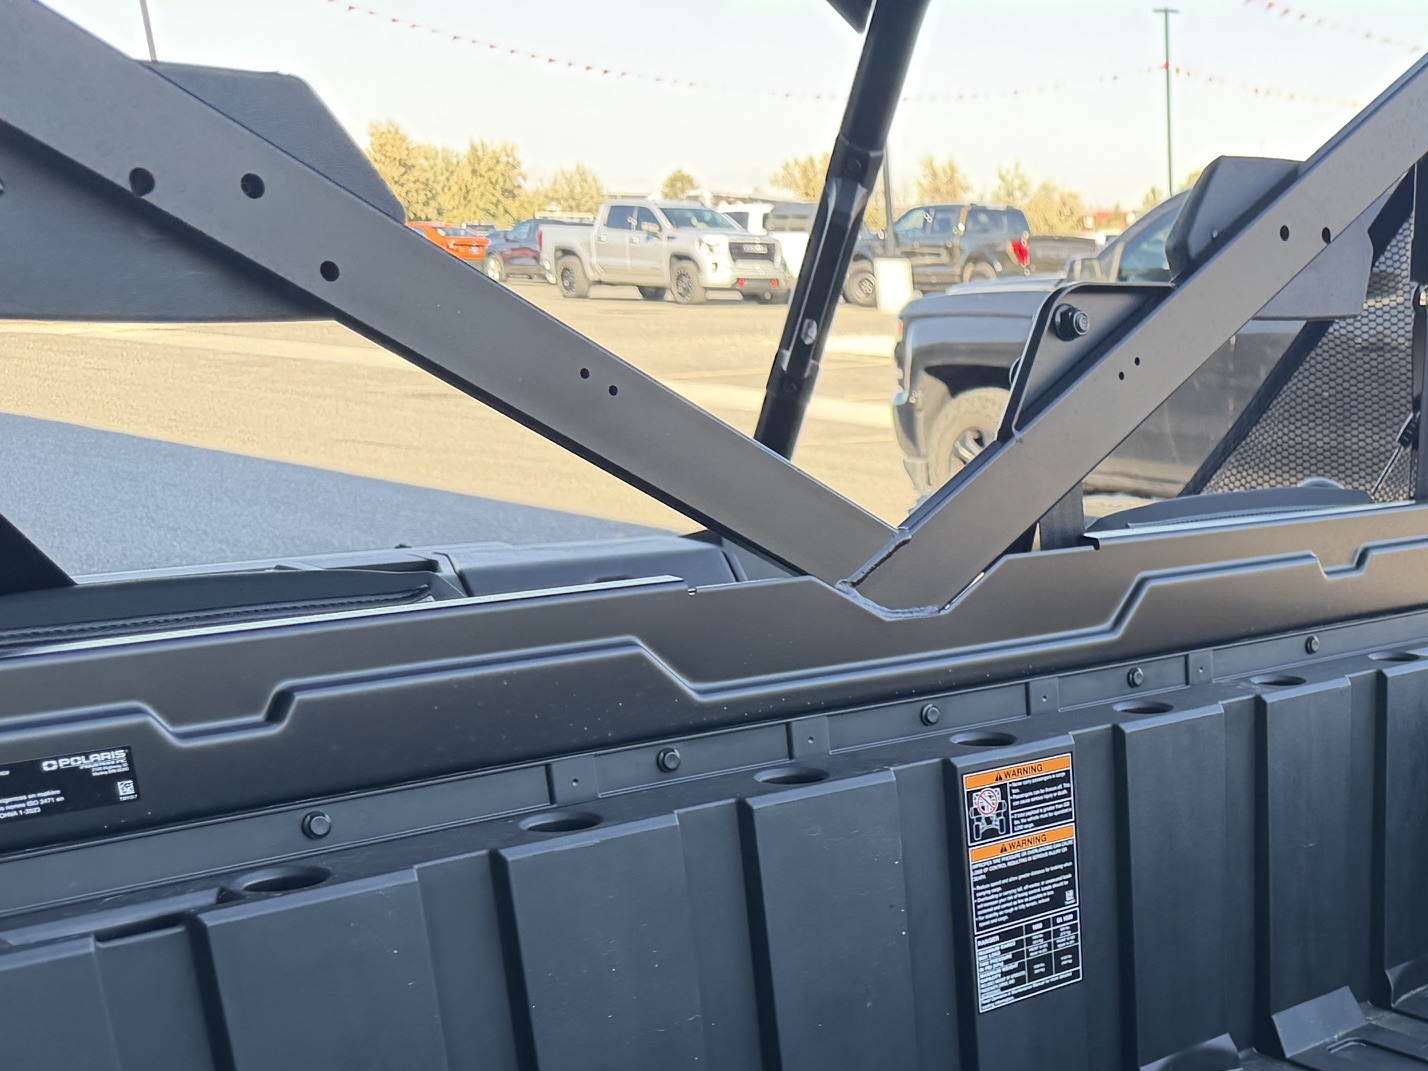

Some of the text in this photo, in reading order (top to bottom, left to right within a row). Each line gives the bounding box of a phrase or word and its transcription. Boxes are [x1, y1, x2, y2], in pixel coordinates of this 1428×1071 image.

[59, 750, 126, 768] POLARIS
[1004, 764, 1042, 779] WARNING
[1009, 834, 1047, 850] WARNING
